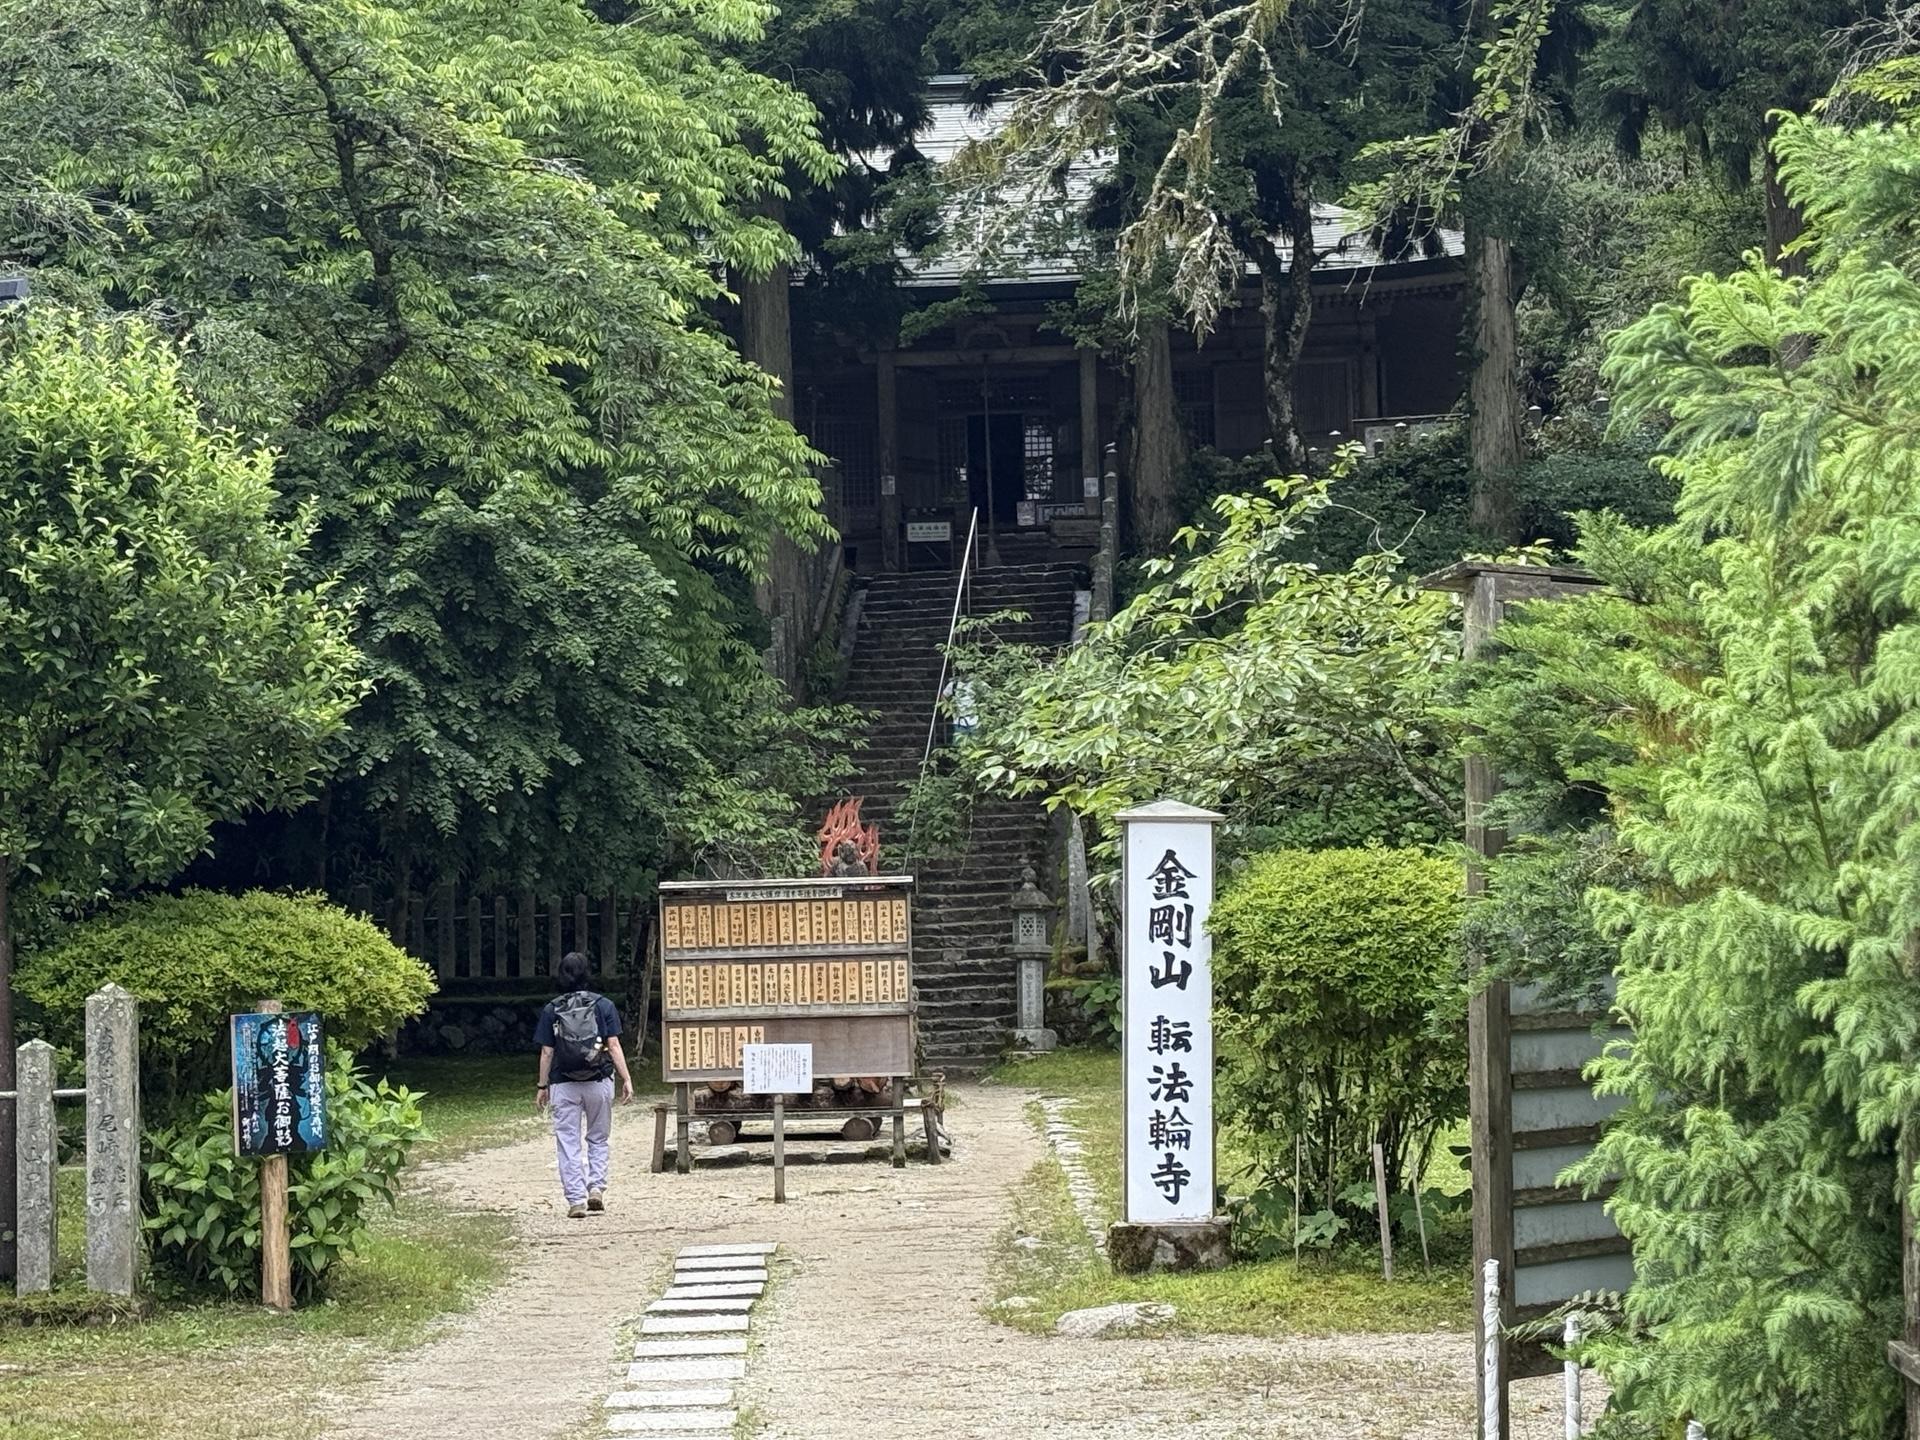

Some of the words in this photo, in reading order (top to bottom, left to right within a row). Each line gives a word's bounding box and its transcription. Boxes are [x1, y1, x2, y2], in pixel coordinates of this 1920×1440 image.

[1146, 849, 1198, 992] 金剛山
[1146, 1015, 1194, 1205] 転法輪寺
